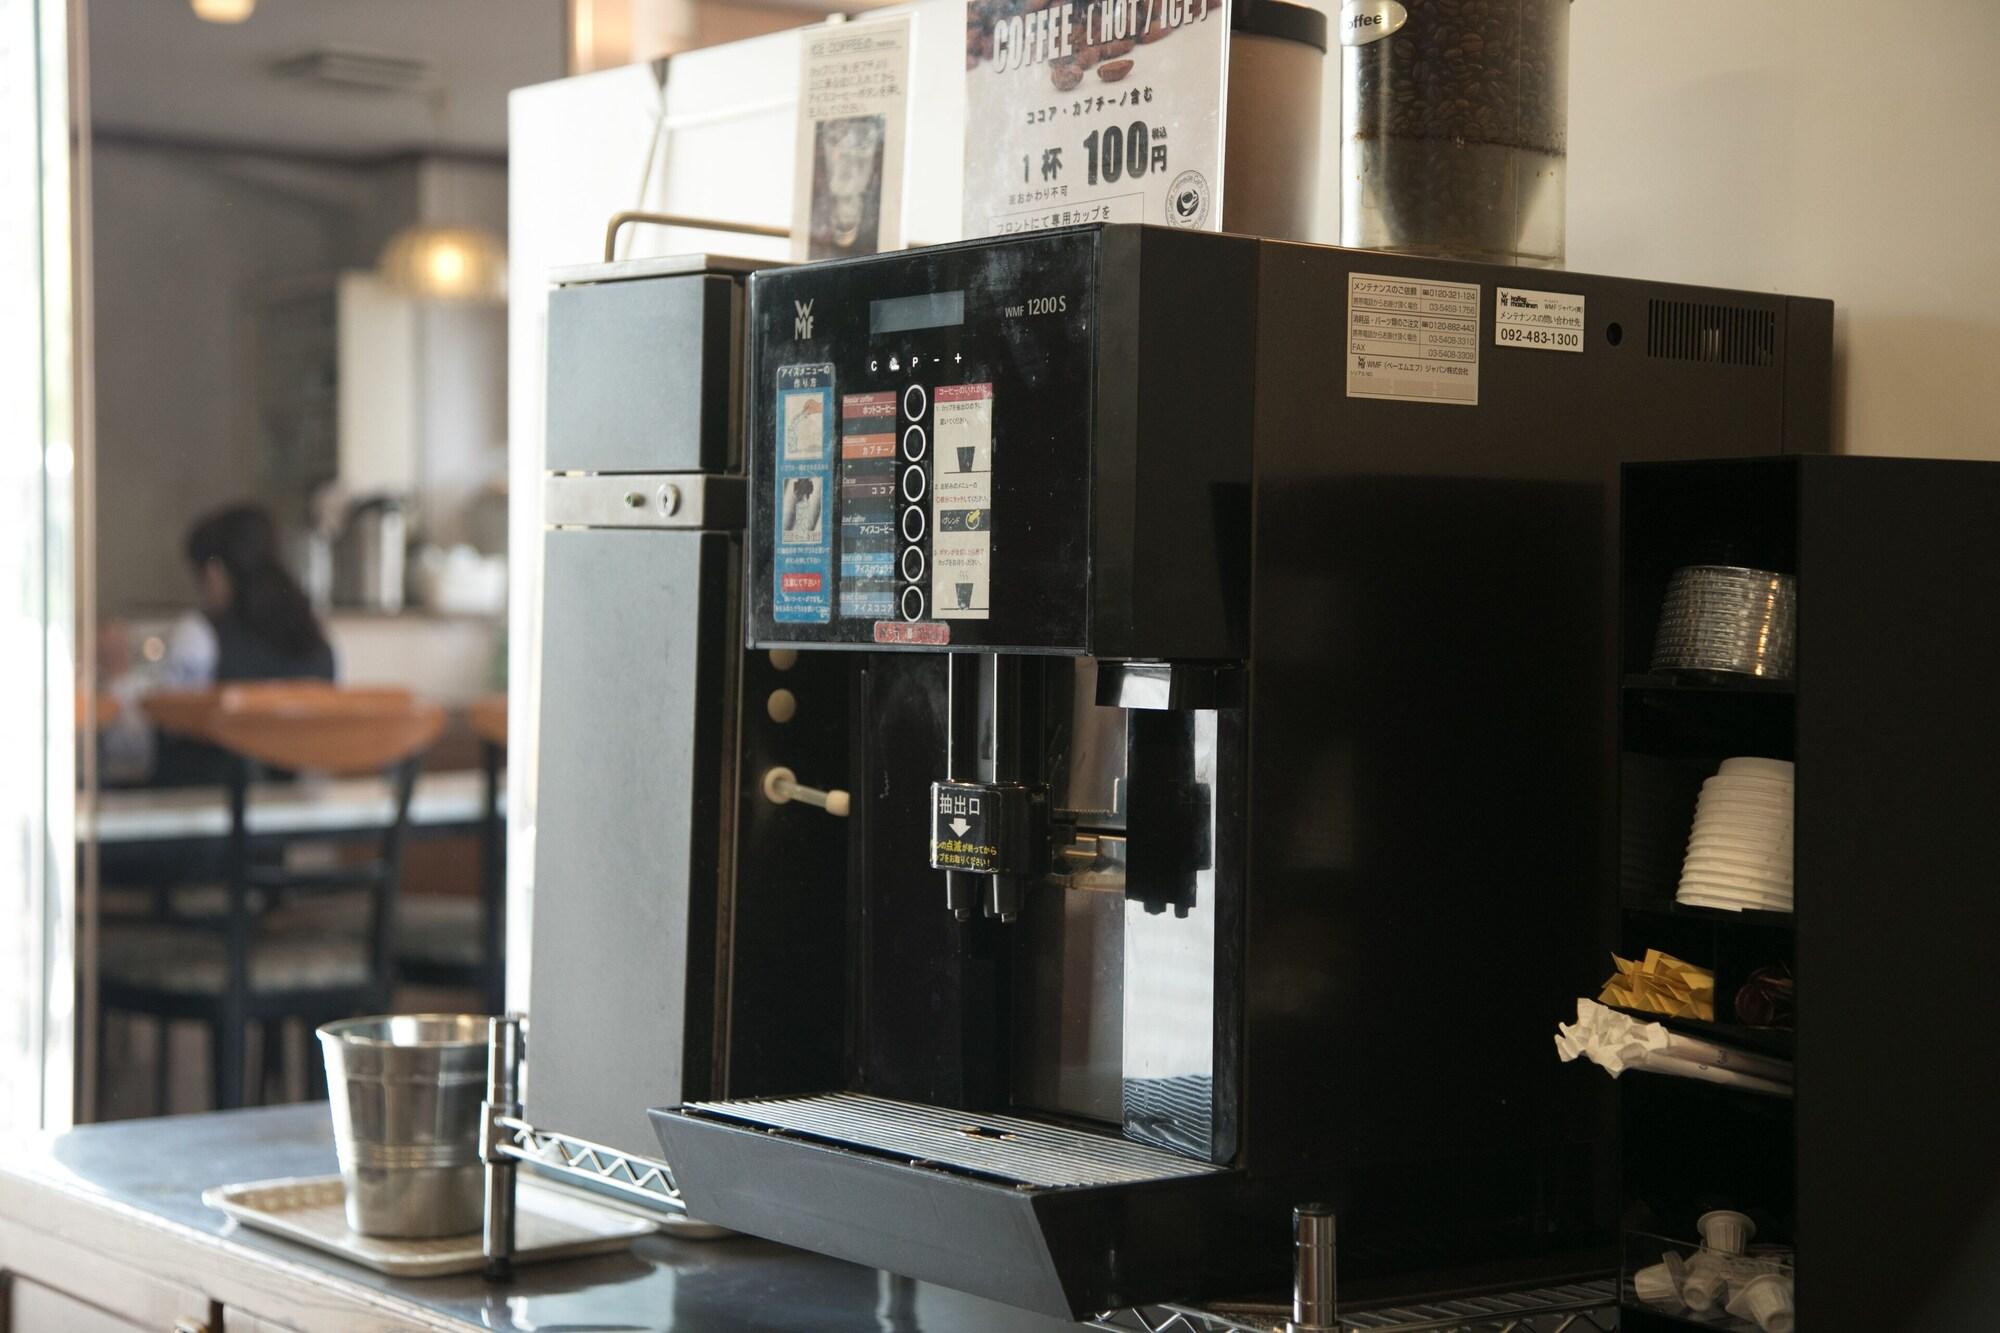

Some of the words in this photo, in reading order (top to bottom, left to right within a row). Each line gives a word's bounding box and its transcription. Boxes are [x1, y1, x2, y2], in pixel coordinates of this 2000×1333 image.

[993, 4, 1073, 73] COFFEE
[1027, 86, 1153, 125] ココア・カプチーノ含む
[1005, 305, 1024, 318] WMF
[1501, 328, 1578, 346] 092-483-1300
[1352, 343, 1366, 352] FAX
[871, 360, 878, 372] C
[912, 356, 919, 368] P
[863, 404, 896, 415] ホットコーヒー
[863, 445, 896, 456] カプチーノ
[872, 485, 895, 495] ココア
[860, 525, 895, 535] アイスコーヒー
[855, 602, 894, 613] アイスココア
[939, 792, 980, 816] 抽出口
